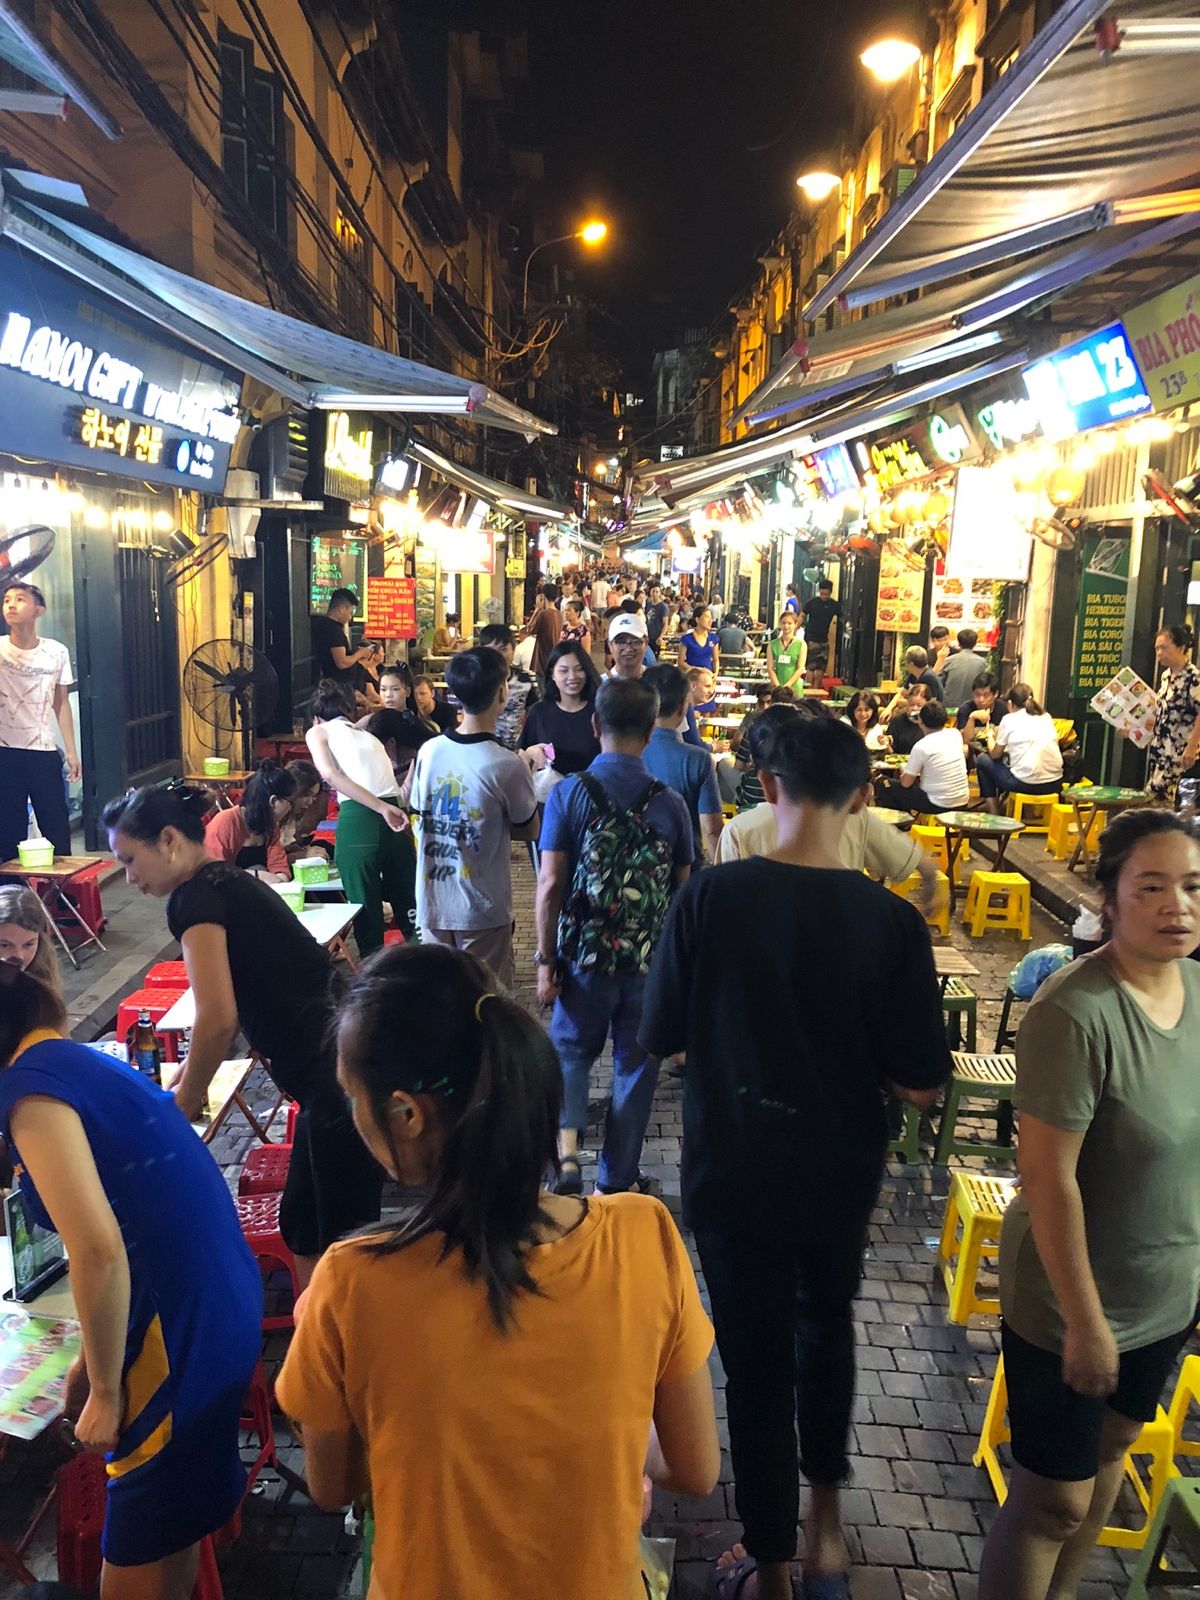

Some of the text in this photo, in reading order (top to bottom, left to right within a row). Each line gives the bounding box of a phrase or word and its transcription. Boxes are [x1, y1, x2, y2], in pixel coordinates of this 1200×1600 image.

[81, 408, 130, 457] 하노이
[134, 425, 163, 464] 선물
[1086, 594, 1101, 604] BIA
[1084, 617, 1099, 627] BIA
[1083, 630, 1123, 639] BIA CORO
[1082, 641, 1097, 651] BIA
[1081, 653, 1095, 663] BIA
[1079, 665, 1094, 675] BIA
[1078, 677, 1093, 687] BIA
[428, 864, 457, 882] UP
